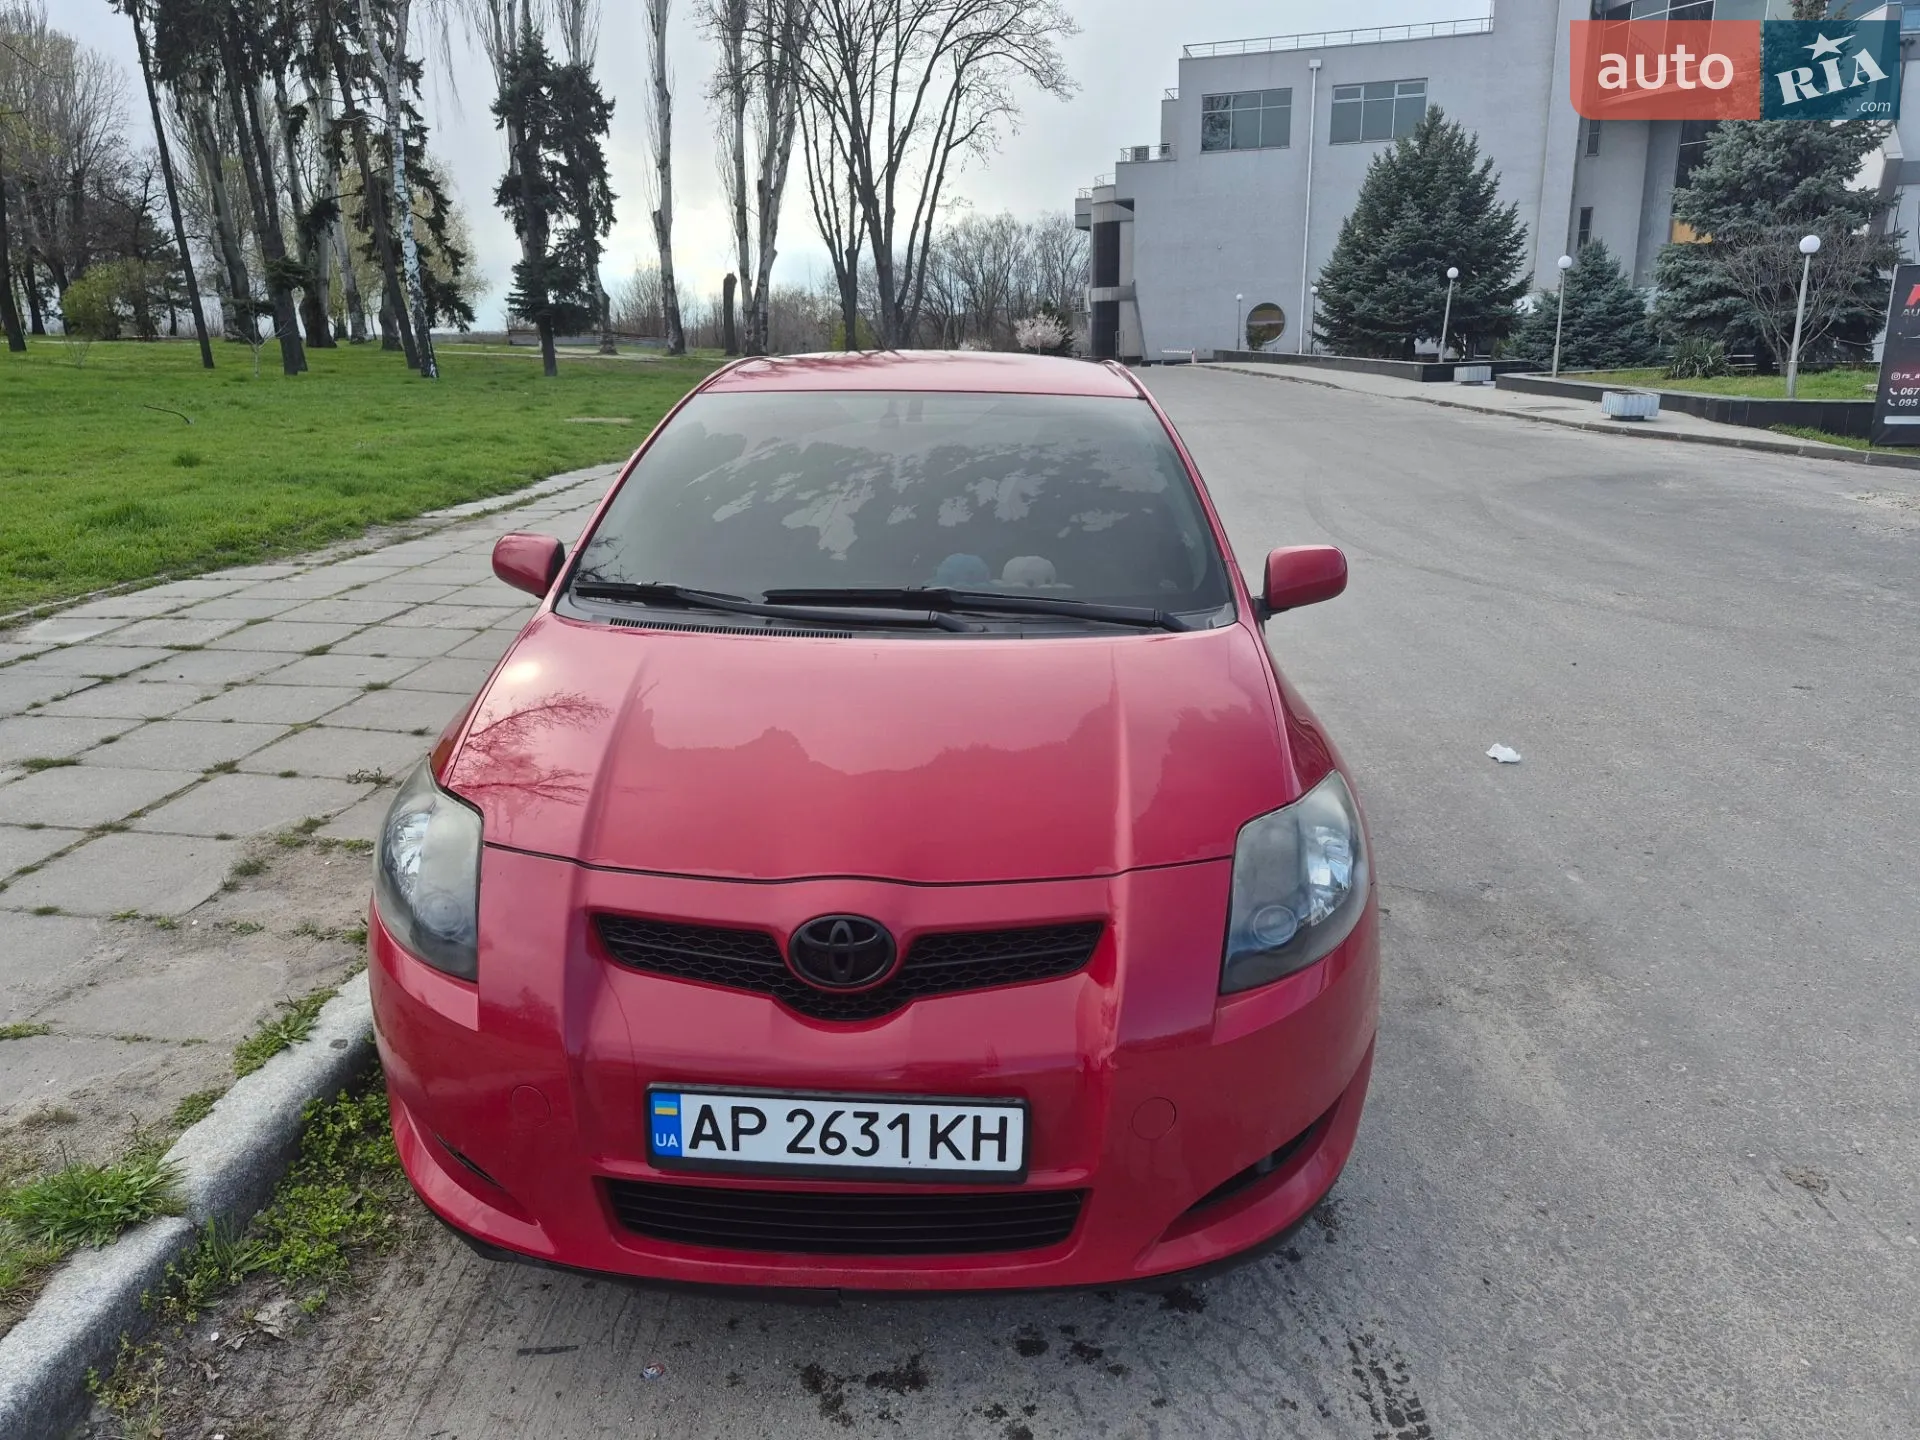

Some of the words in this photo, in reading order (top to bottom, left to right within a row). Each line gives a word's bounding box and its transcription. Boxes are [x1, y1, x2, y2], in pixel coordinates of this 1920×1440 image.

[1900, 387, 1920, 396] 067
[1898, 398, 1919, 407] 095
[689, 1105, 767, 1152] AP
[786, 1108, 911, 1159] 2631
[929, 1114, 1008, 1163] KH
[655, 1133, 679, 1148] UA
